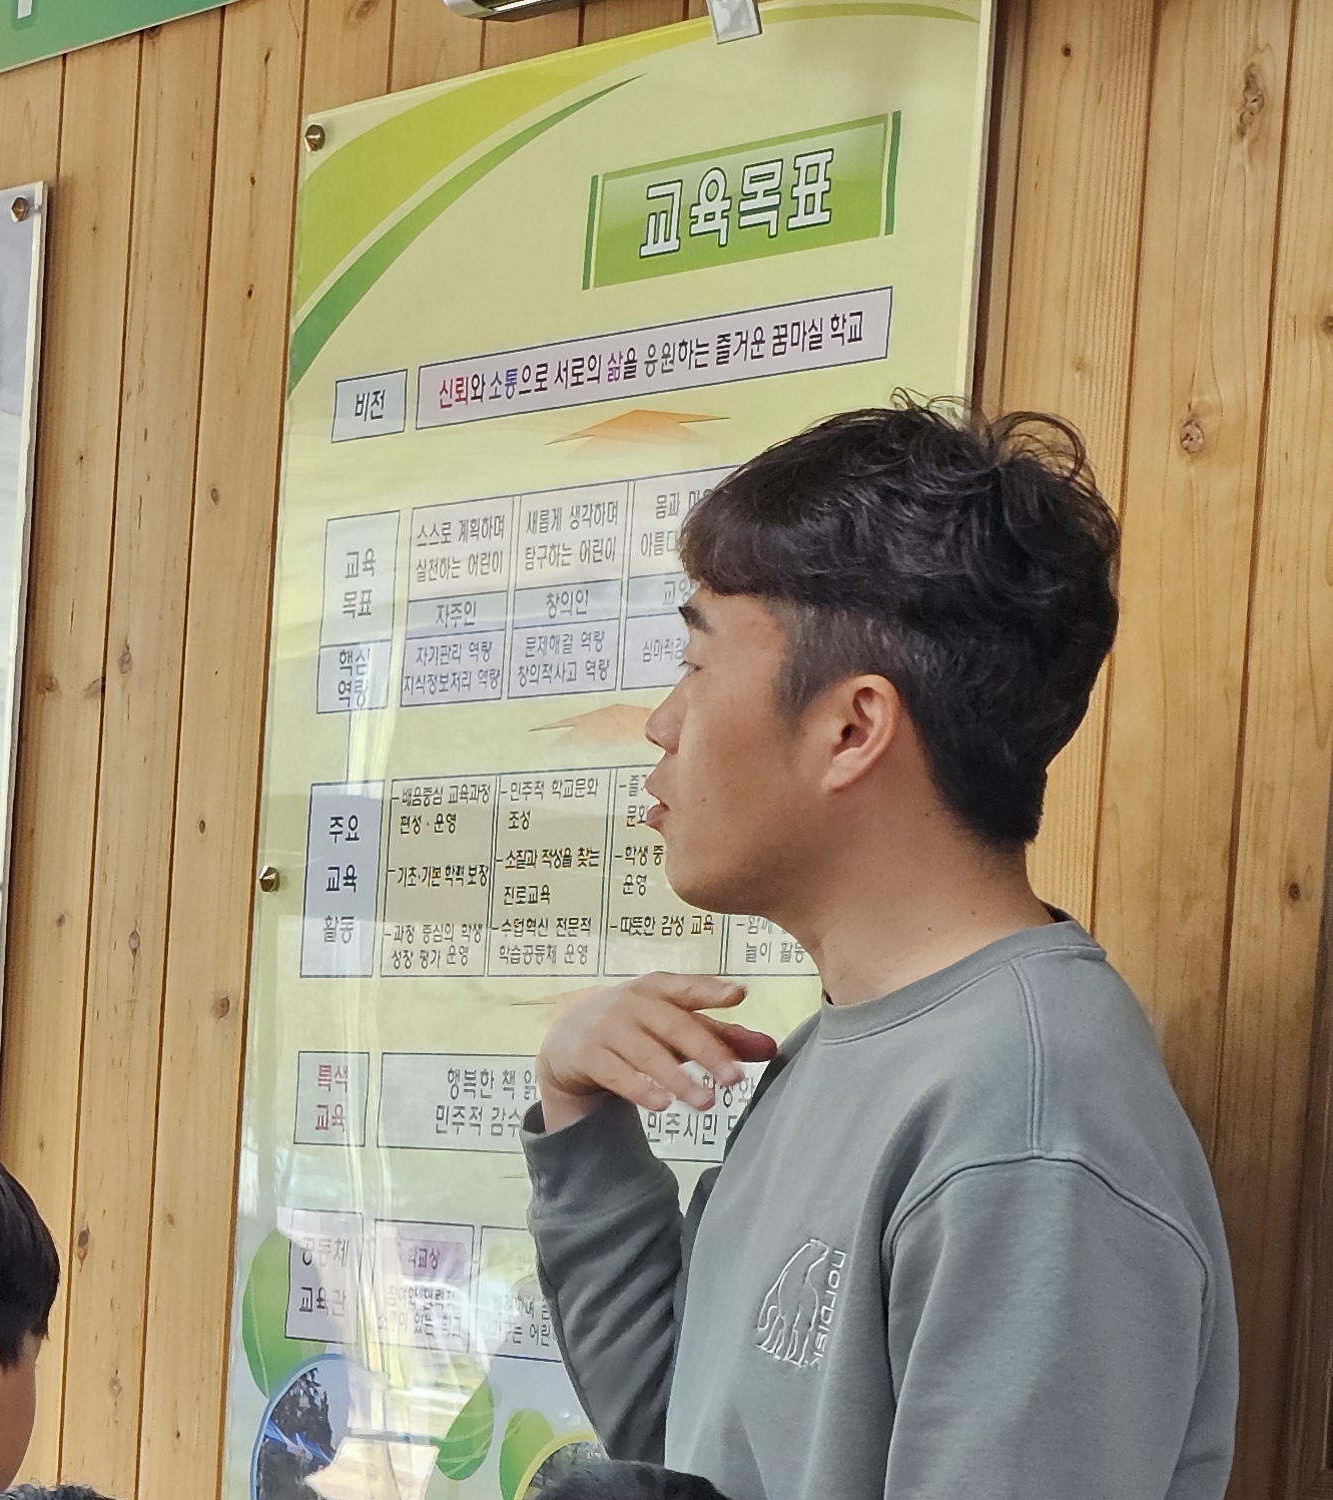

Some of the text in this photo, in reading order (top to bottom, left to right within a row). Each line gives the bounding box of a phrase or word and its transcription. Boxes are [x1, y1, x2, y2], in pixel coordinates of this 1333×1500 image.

[638, 147, 835, 259] 교육목표
[439, 311, 864, 408] 신뢰와 소통으로 서로의 삶을 응원하는 즐거운 꿈마실 학교
[354, 388, 386, 422] 비전
[526, 499, 620, 536] 새롭게 생각하며
[655, 492, 680, 520] 몸과
[416, 513, 506, 548] 스스로 계획하며
[344, 547, 377, 580] 교육
[416, 549, 504, 583] 실천하는 어린이
[525, 536, 617, 572] 탐구하는 어린이
[342, 587, 373, 620] 목표
[434, 598, 478, 630] 자주인
[545, 588, 589, 619] 창의인
[416, 640, 493, 667] 자기관리 역량
[525, 628, 606, 659] 문제해결 역량
[339, 647, 371, 676] 핵심
[517, 657, 611, 689] 창의적사고 역량
[337, 679, 369, 708] 역량
[403, 667, 501, 695] 지식정보처리 역량
[448, 784, 492, 805] 교육과정
[509, 777, 599, 802] 민주적 학교문화
[329, 814, 361, 844] 주요
[399, 812, 458, 835] 편성 운영
[508, 810, 531, 831] 조성
[504, 847, 600, 870] 소질과 적성을 찾는
[625, 845, 649, 867] 학생
[326, 864, 358, 893] 교육
[444, 864, 466, 888] 학력
[467, 863, 490, 887] 보장
[622, 873, 648, 897] 운영
[503, 884, 551, 906] 진로교육
[323, 914, 356, 945] 활동
[392, 922, 483, 945] 과정 중심의 학생
[500, 916, 593, 938] 수업혁신 전문적
[621, 914, 715, 937] 따뜻한 감성 교육
[391, 945, 470, 971] 성장 평가 운영
[498, 943, 589, 966] 학습공동체 운영
[745, 941, 773, 964] 놀이
[447, 1067, 516, 1101] 행복한 책
[315, 1102, 346, 1133] 교육
[435, 1104, 483, 1136] 민주적
[646, 1111, 719, 1146] 민주시민
